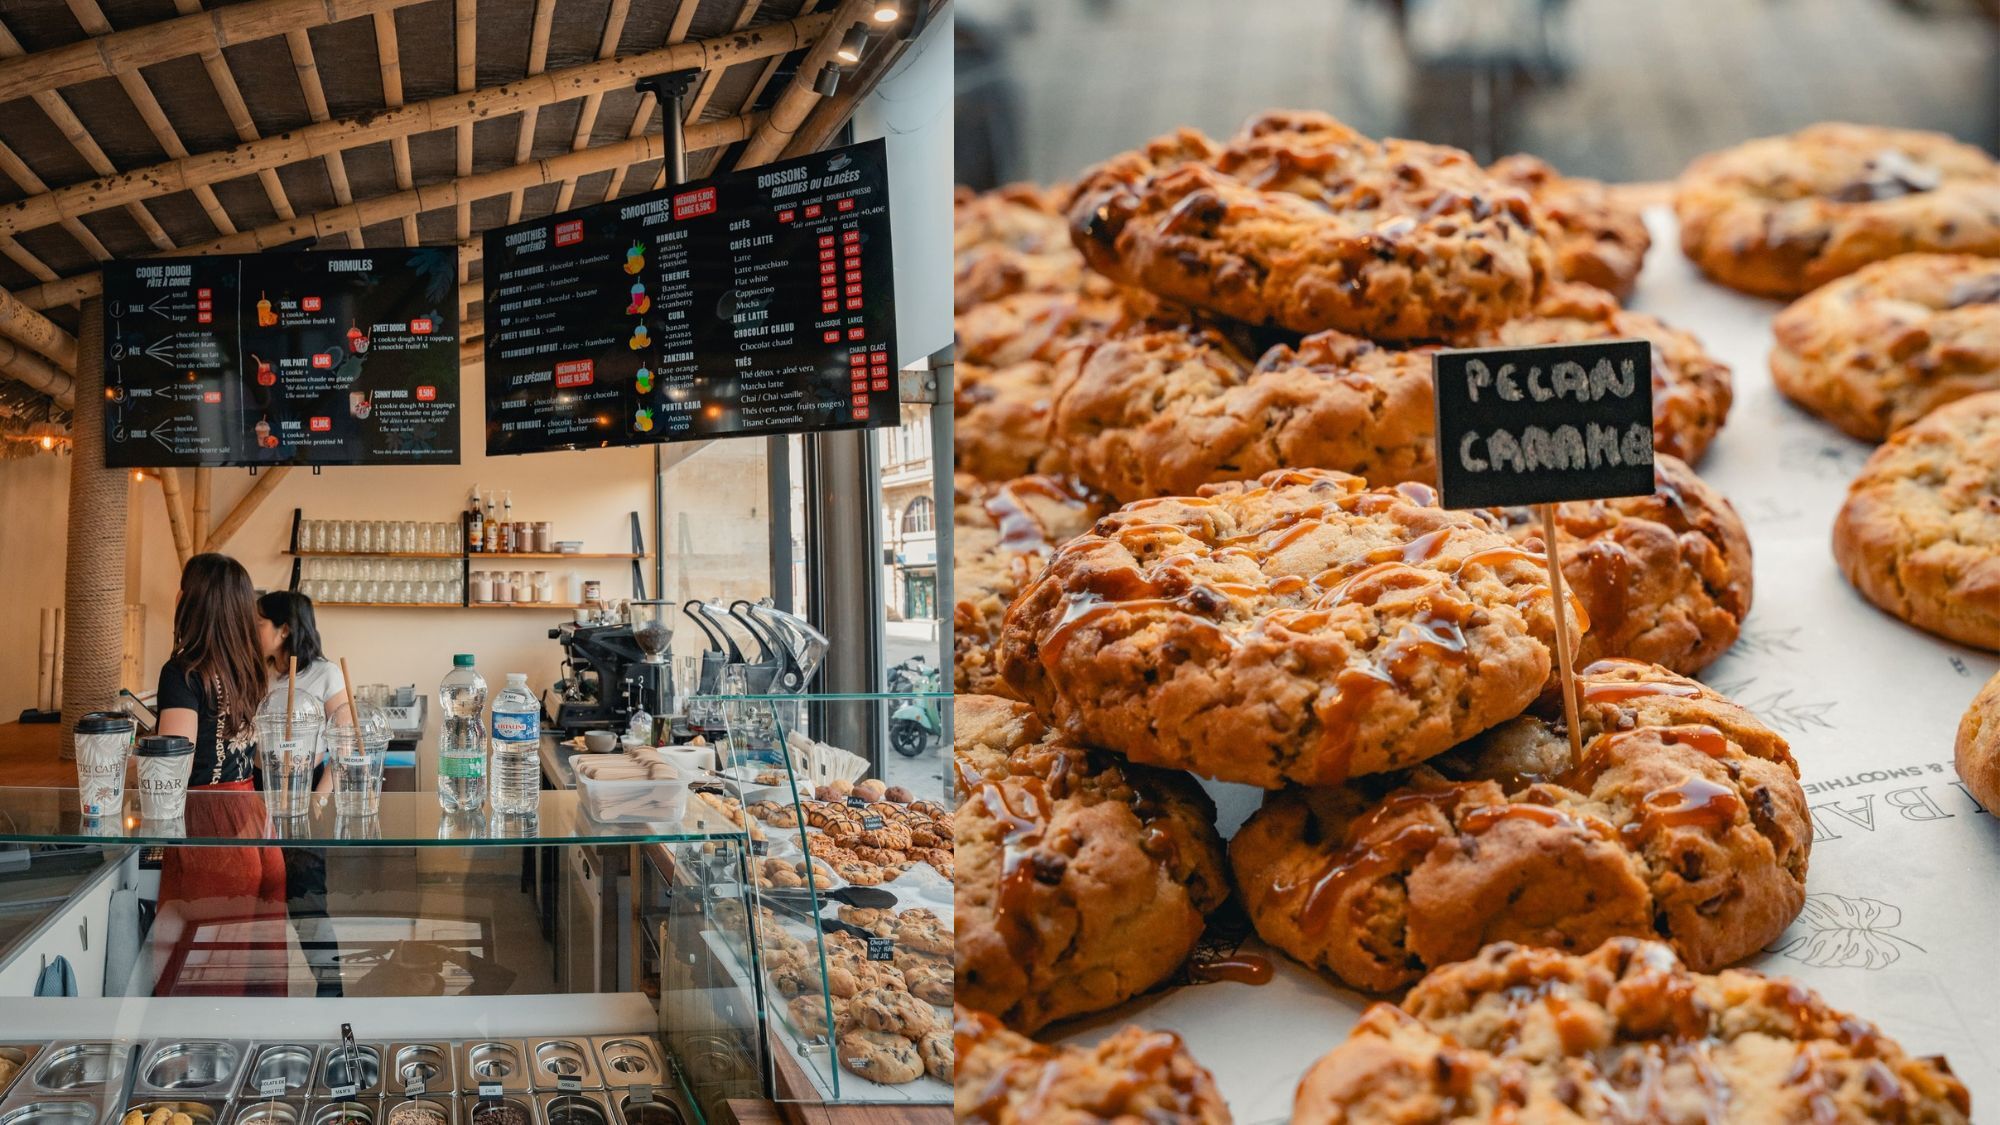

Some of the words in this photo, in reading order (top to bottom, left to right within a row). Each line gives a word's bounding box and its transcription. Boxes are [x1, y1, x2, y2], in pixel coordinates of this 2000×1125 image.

[758, 166, 808, 189] BOISSONS
[772, 181, 808, 198] CHAUDES
[810, 179, 822, 190] OU
[823, 170, 861, 188] GLACÉES
[827, 192, 845, 201] DOUBLE
[621, 198, 669, 220] SMOOTHIES
[678, 204, 694, 216] LARGE
[774, 202, 797, 212] EXPRESSO
[861, 206, 885, 215] +0,40€
[643, 211, 669, 226] FRUITÉS
[730, 220, 750, 231] CAFÉS
[816, 226, 834, 234] CHAUD
[843, 221, 858, 230] GLACÉ
[506, 228, 546, 247] SMOOTHIES
[656, 230, 688, 243] HONOLULU
[516, 240, 546, 255] PROTÉINÉS
[660, 244, 682, 252] ananas
[730, 238, 750, 250] CAFÉS
[753, 235, 774, 246] LATTE
[658, 251, 688, 260] +mangue
[734, 254, 751, 262] Latte
[328, 260, 373, 272] FORMULES
[515, 265, 544, 278] FRAMBOISE
[550, 261, 574, 272] chocolat
[580, 254, 610, 264] framboise
[660, 259, 688, 269] +passion
[734, 266, 752, 274] Latte
[754, 260, 788, 270] macchiato
[136, 266, 163, 278] COOKIE
[165, 265, 191, 276] DOUGH
[662, 270, 690, 282] TENERIFE
[147, 277, 161, 288] PÂTE
[169, 277, 191, 286] COOKIE
[527, 282, 544, 290] vanille
[551, 276, 579, 286] framboise
[750, 275, 768, 284] white
[662, 284, 686, 292] Banane
[736, 286, 774, 298] Cappuccino
[500, 301, 521, 312] PERFECT
[523, 298, 542, 308] MATCH
[546, 294, 570, 303] chocolat
[576, 288, 597, 298] banane
[657, 291, 694, 301] +framboise
[658, 300, 692, 310] +cranberry
[736, 301, 759, 310] Mocha
[536, 312, 556, 320] banane
[668, 311, 684, 320] CUBA
[733, 314, 746, 323] UBE
[748, 310, 768, 320] LATTE
[848, 316, 863, 324] LARGE
[373, 324, 388, 332] SWEET
[390, 324, 406, 332] DOUGH
[815, 319, 841, 328] CLASSIQUE
[501, 332, 517, 340] SWEET
[520, 328, 540, 338] VANILLA
[546, 325, 564, 333] vanille
[734, 326, 768, 338] CHOCOLAT
[771, 322, 794, 334] CHAUD
[665, 332, 692, 340] +ananas
[502, 346, 534, 358] STRAWBERRY
[536, 343, 558, 353] PARFAIT
[585, 337, 615, 346] framboise
[664, 340, 692, 349] +passion
[740, 341, 770, 352] Chocolat
[772, 338, 793, 347] chaud
[870, 342, 886, 351] GLACÉ
[114, 344, 123, 358] 2
[664, 352, 694, 363] ZANZIBAR
[735, 356, 752, 367] THÉS
[512, 376, 522, 385] LES
[524, 371, 552, 383] SPÉCIAUX
[740, 370, 753, 379] Thé
[754, 369, 774, 377] détox
[783, 366, 798, 375] aloé
[558, 375, 573, 384] LARGE
[1466, 357, 1634, 402] PECAN
[666, 382, 694, 390] +passion
[741, 382, 766, 391] Matcha
[130, 389, 152, 398] TOPPINGS
[392, 390, 408, 398] DOUGH
[593, 391, 618, 399] chocolat
[741, 395, 756, 403] Chai
[780, 390, 803, 400] vanille
[662, 402, 682, 412] PUNTA
[684, 400, 701, 410] CANA
[760, 405, 778, 414] (vert,
[780, 404, 796, 412] noir,
[796, 401, 816, 410] fruits
[818, 400, 845, 410] rouges)
[502, 422, 514, 431] POST
[517, 420, 541, 430] WORKOUT
[548, 419, 572, 427] chocolat
[742, 419, 764, 427] Tisane
[766, 416, 804, 425] Camomille
[156, 779, 182, 790] BAR
